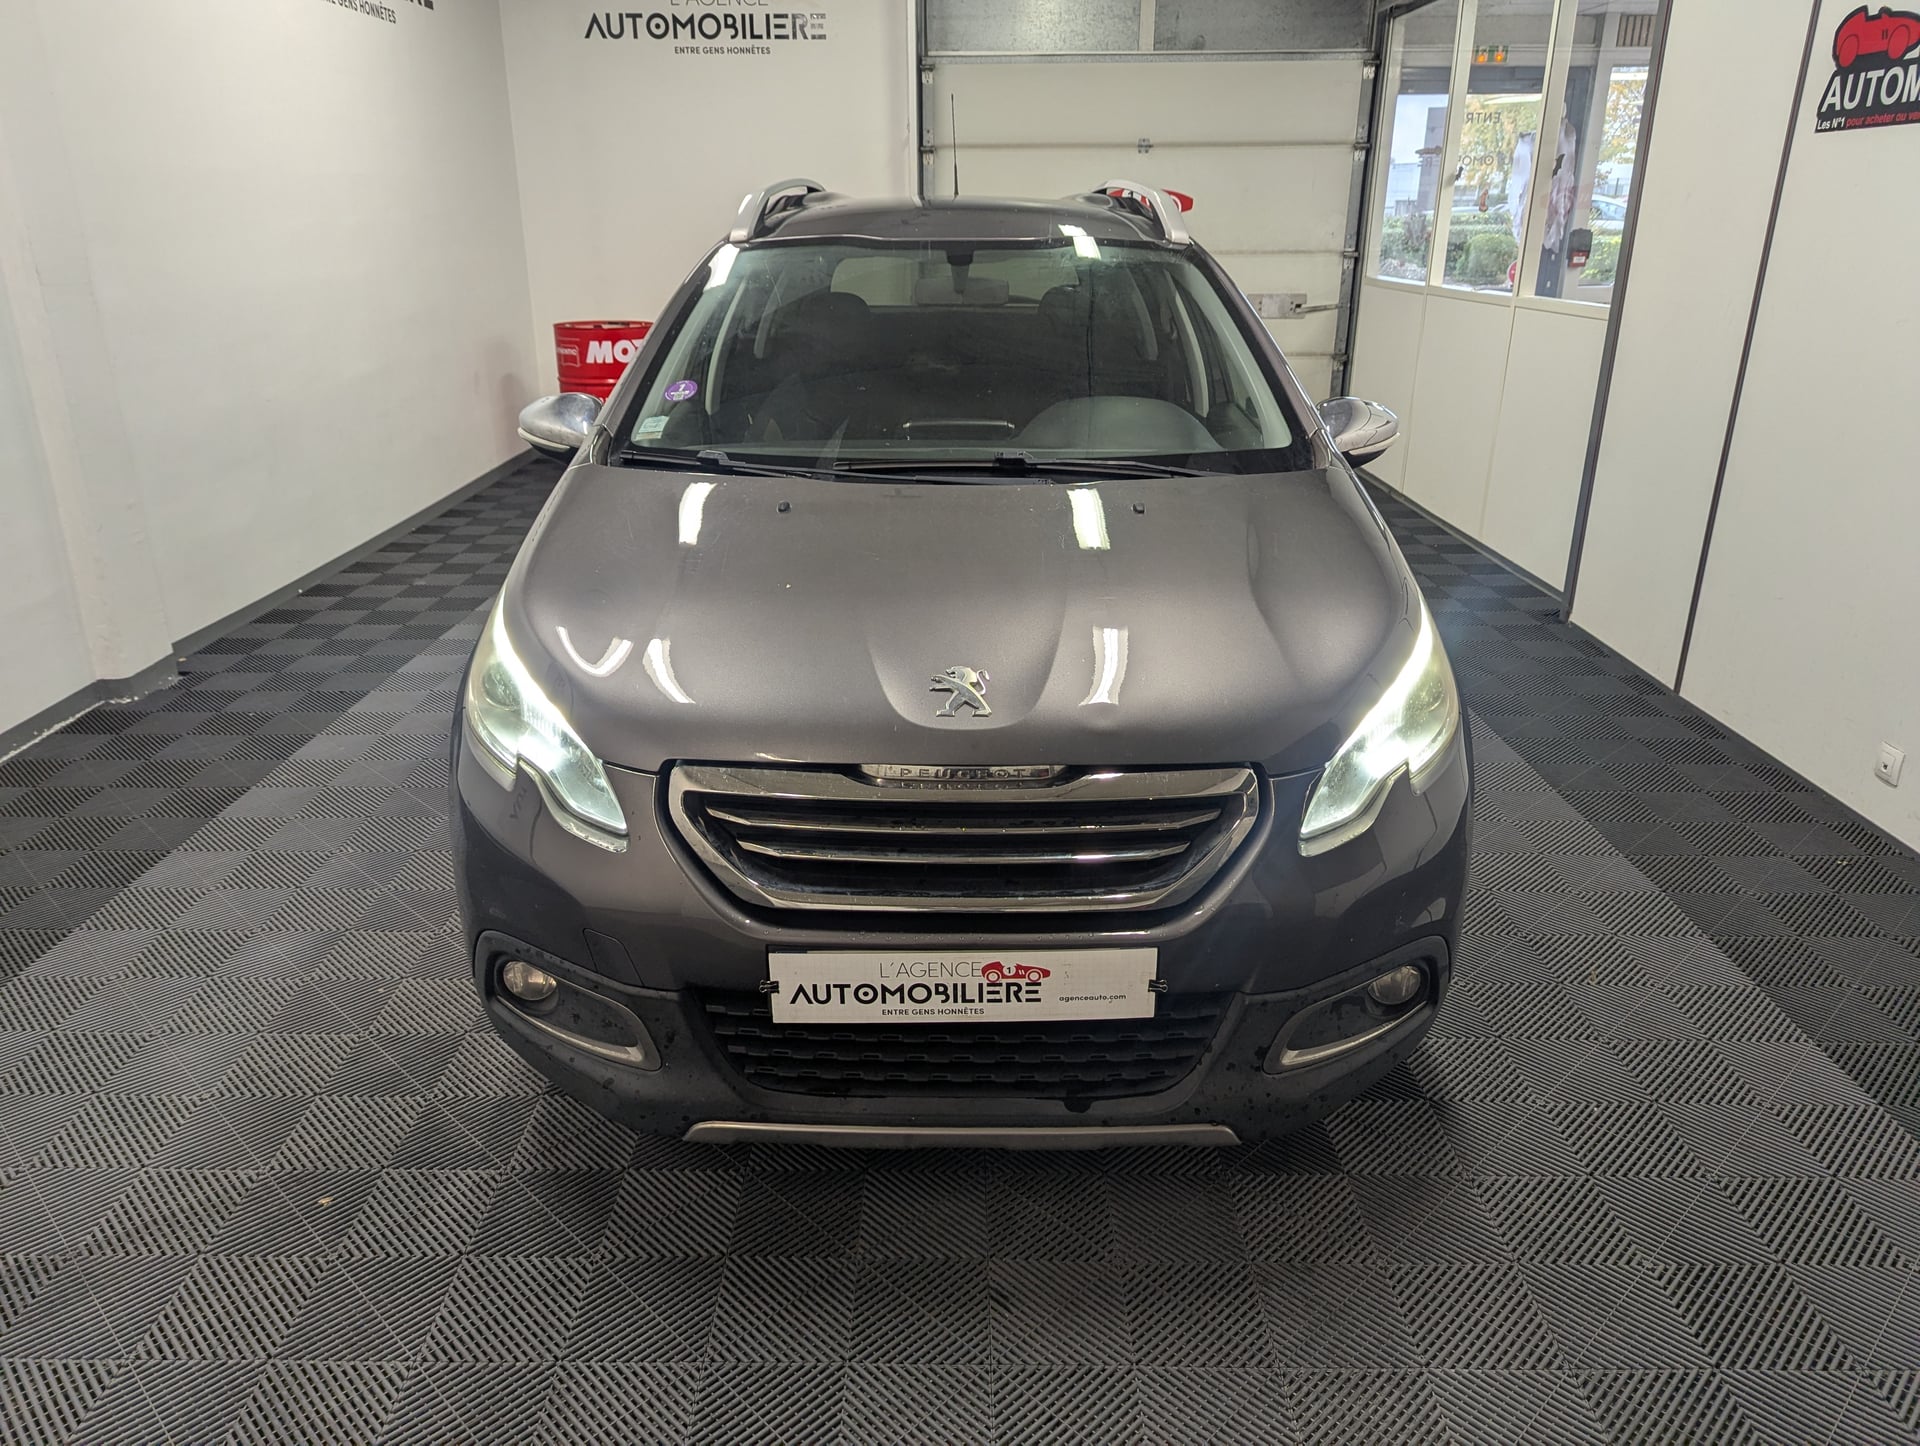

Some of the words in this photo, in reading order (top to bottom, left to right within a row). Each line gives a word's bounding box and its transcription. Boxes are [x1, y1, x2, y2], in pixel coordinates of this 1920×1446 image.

[359, 0, 397, 24] HONNÊTES
[584, 13, 827, 40] AUTOMOBILIERE
[674, 46, 700, 54] ENTRE
[703, 46, 725, 54] GENS
[727, 44, 771, 54] HONNÊTES
[1817, 120, 1831, 130] Les
[1831, 116, 1846, 129] N°1
[1845, 117, 1864, 129] pour
[1864, 112, 1896, 126] acheter
[1895, 112, 1908, 122] ou
[900, 767, 1026, 779] PEUGEOT
[879, 961, 982, 979] L'AGENCE
[1006, 966, 1012, 974] 1
[789, 982, 1042, 1005] AUTOMOBILIERE
[1058, 994, 1127, 1003] agenceauto.com
[881, 1008, 910, 1016] ENTRE
[911, 1008, 936, 1016] GENS
[937, 1006, 985, 1016] HONNÊTES
